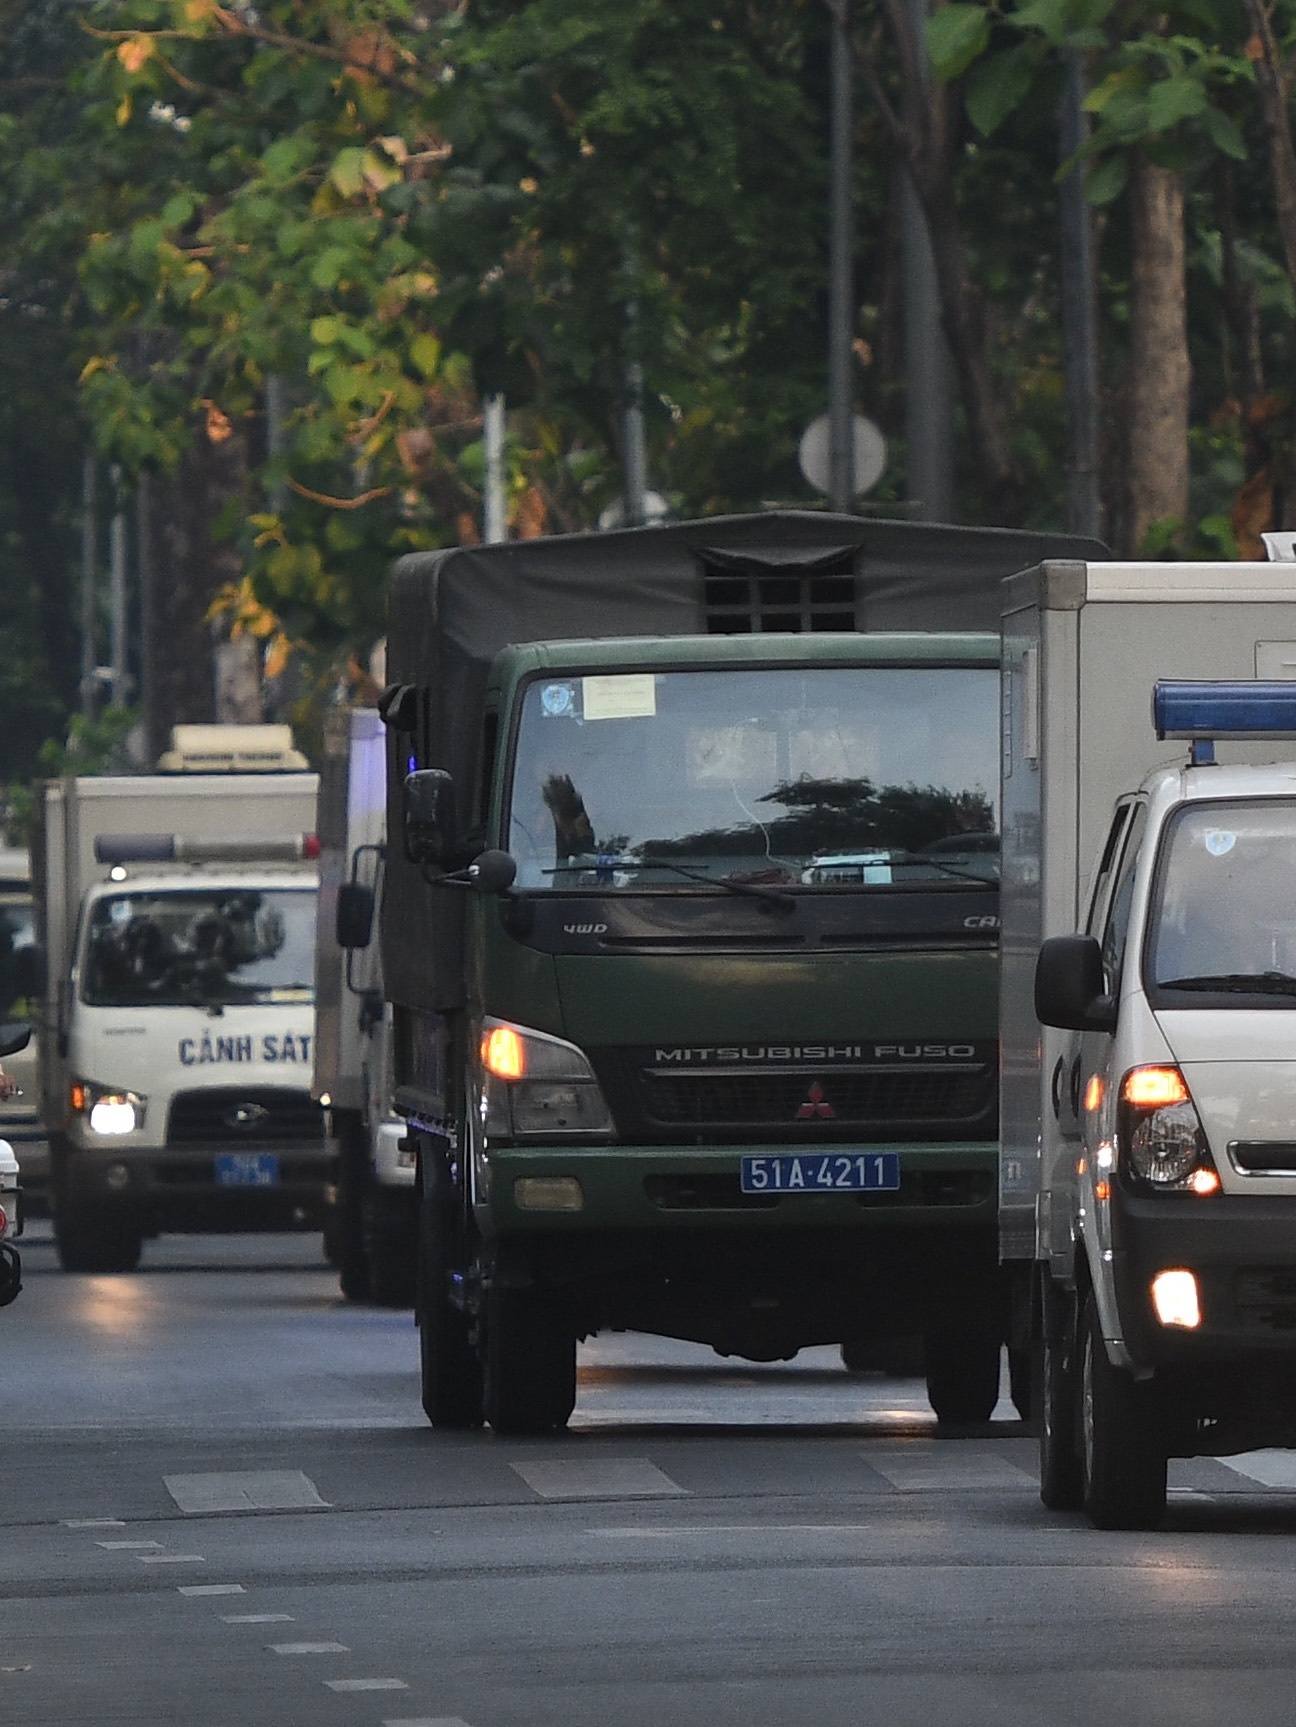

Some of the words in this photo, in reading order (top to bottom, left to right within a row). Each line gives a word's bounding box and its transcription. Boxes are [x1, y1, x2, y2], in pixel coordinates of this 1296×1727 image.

[563, 923, 608, 934] 4WD
[655, 1046, 861, 1061] MITSUBISHI
[874, 1044, 976, 1058] FUSO
